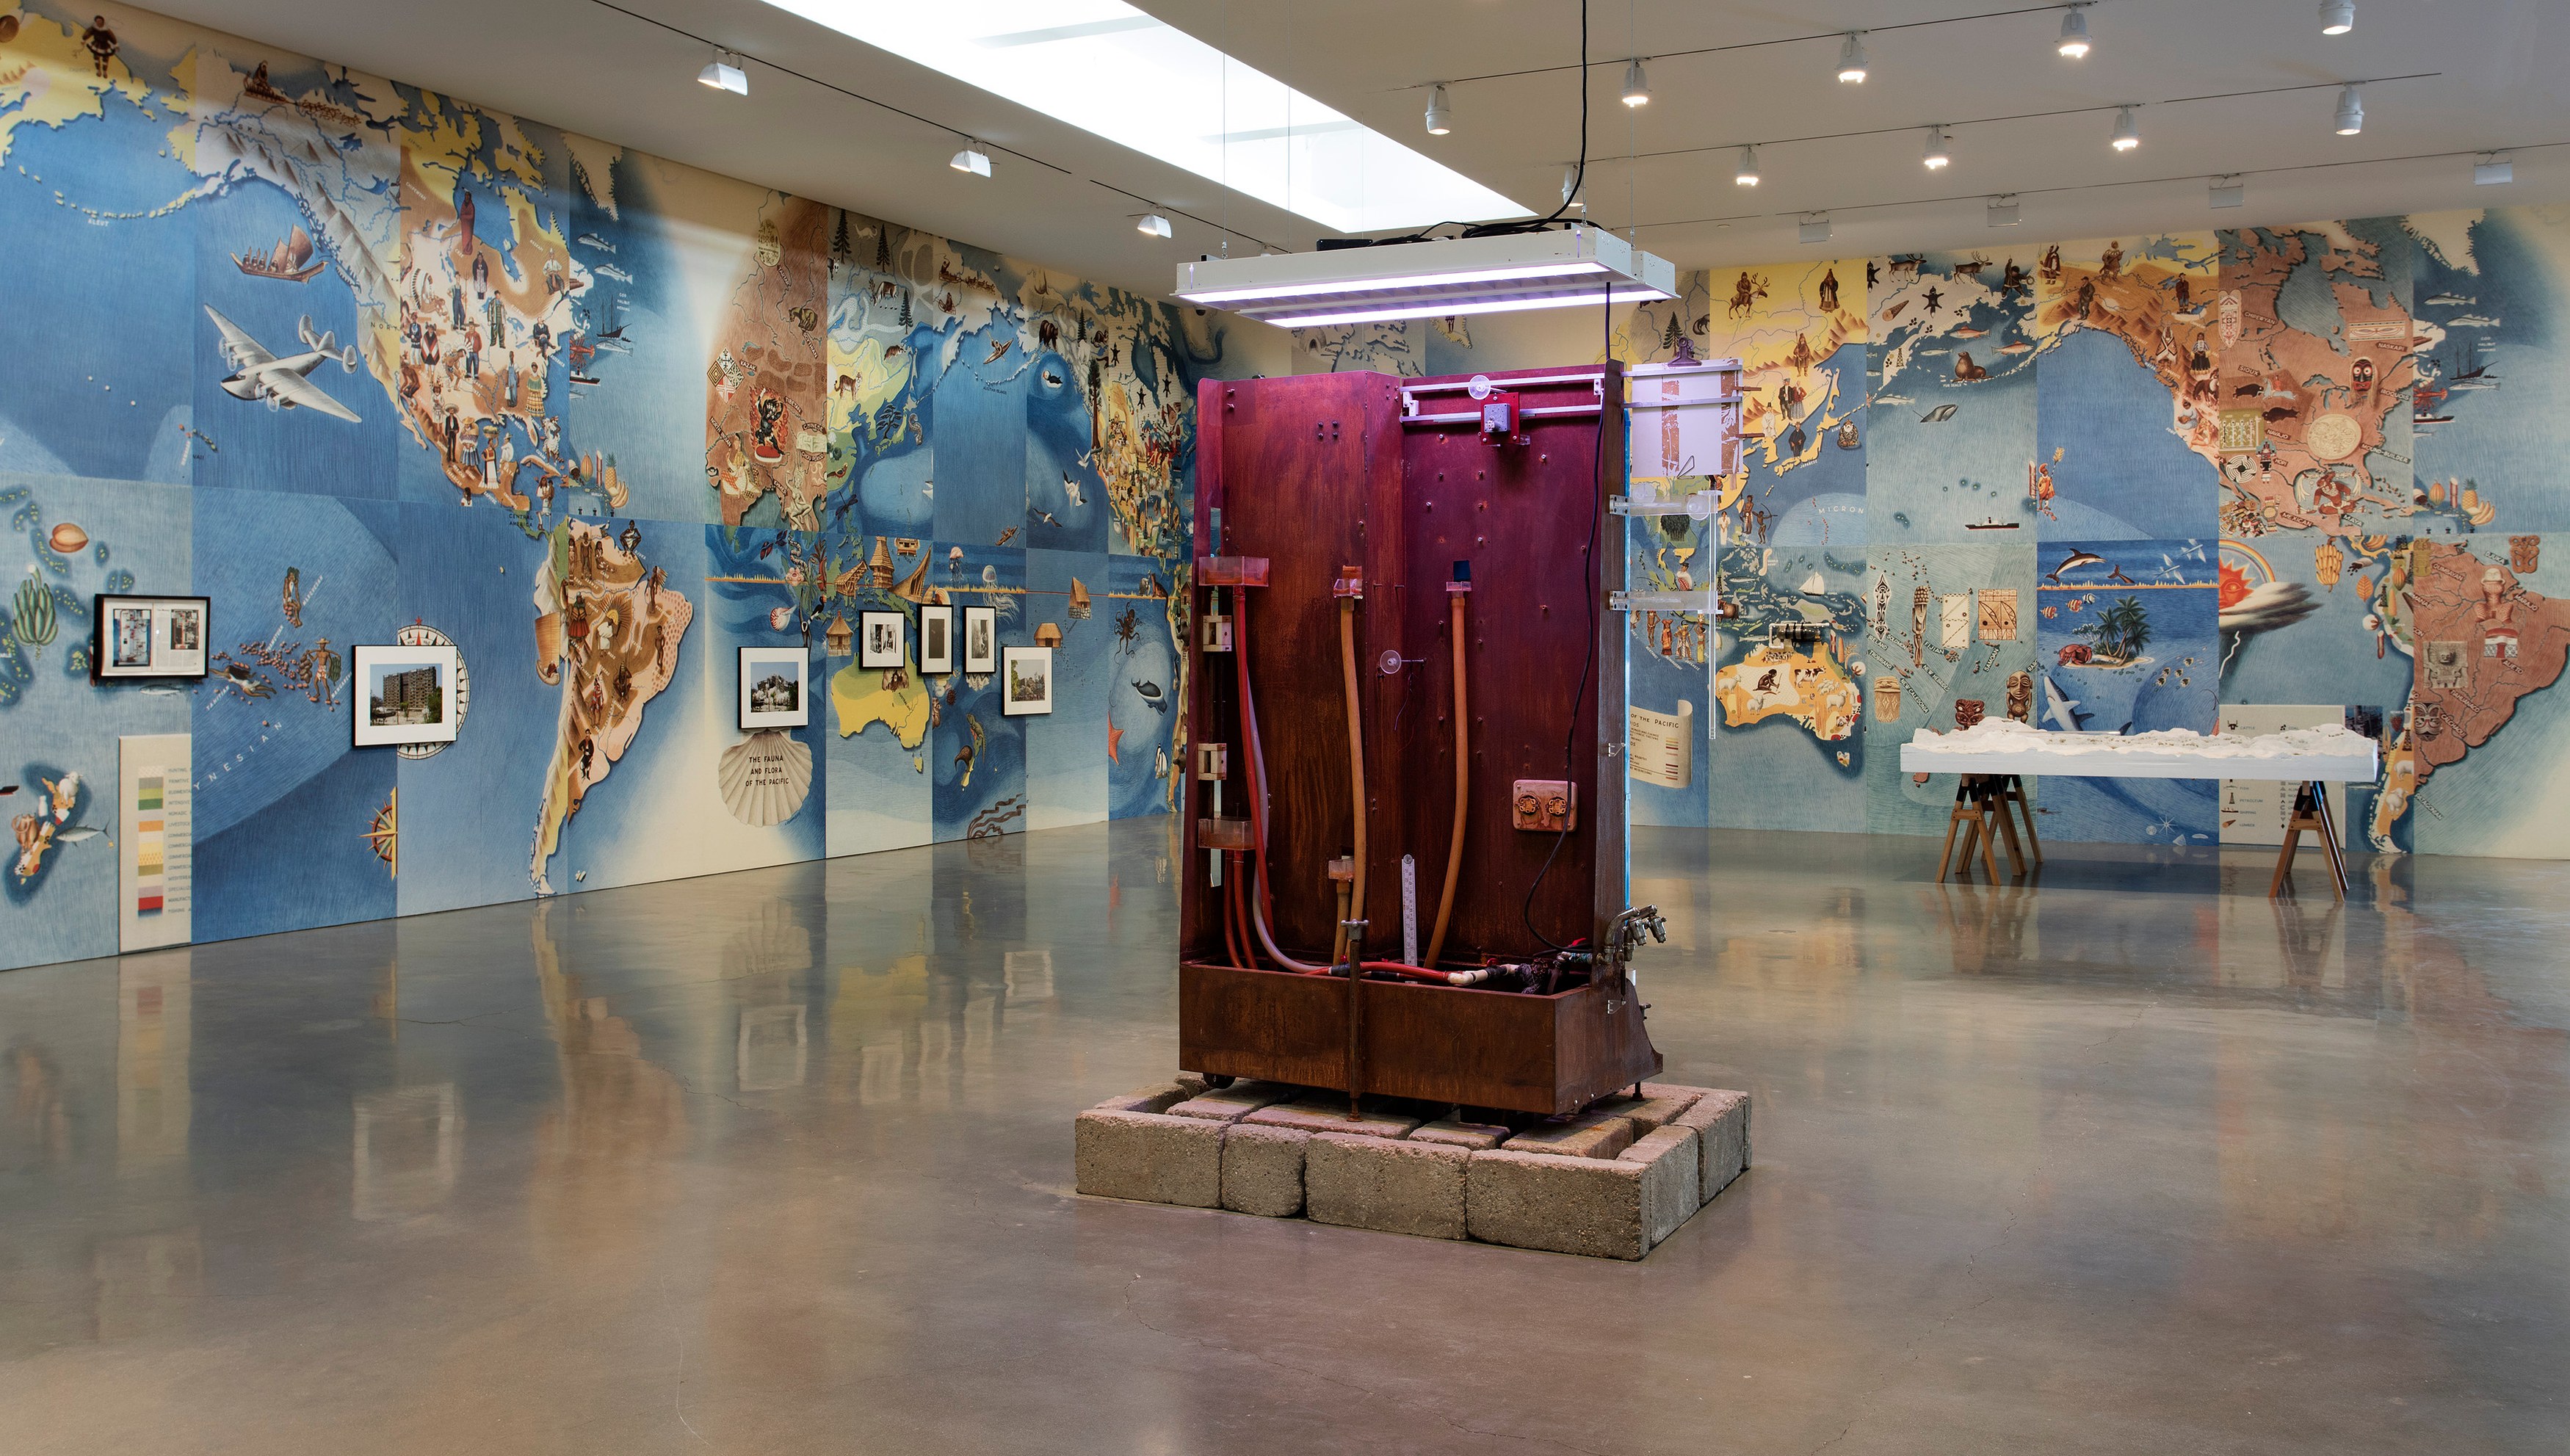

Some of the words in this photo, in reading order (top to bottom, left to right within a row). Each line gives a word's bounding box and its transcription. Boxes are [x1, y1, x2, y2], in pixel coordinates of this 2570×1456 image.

[203, 115, 264, 135] AASKA
[2244, 311, 2276, 325] CHIPEWYAN
[2378, 343, 2406, 351] NASKAPI
[740, 360, 756, 372] KAZAK
[2240, 366, 2259, 376] SIOUX
[2380, 389, 2409, 401] IROQUOIS
[786, 397, 801, 413] TIBETAN
[803, 424, 824, 432] CHINESE
[2267, 430, 2289, 439] NAVAJO
[2361, 444, 2408, 463] MOUND-BUILDER
[1818, 505, 1864, 515] MICRON
[2283, 513, 2312, 527] MEXICAN
[2344, 515, 2363, 527] MAYA
[2485, 551, 2505, 564] DJUKA
[2514, 595, 2538, 612] MARAJO
[1867, 635, 1888, 651] IRELAND
[1887, 634, 1907, 650] SOLOMON
[1924, 640, 1944, 654] FIJIAN
[1869, 651, 1892, 670] TROBRIAND
[1984, 648, 1999, 672] SAMOAN
[2502, 661, 2523, 674] AUETO
[1922, 664, 1933, 676] NEW
[1931, 673, 1950, 692] HEBRIDES
[1900, 678, 1911, 690] NEW
[1909, 689, 1929, 714] CALEDONIA
[1654, 719, 1679, 728] PACIFIC
[193, 722, 282, 791] YNESIAN
[2415, 794, 2444, 820] PATAGONIAN
